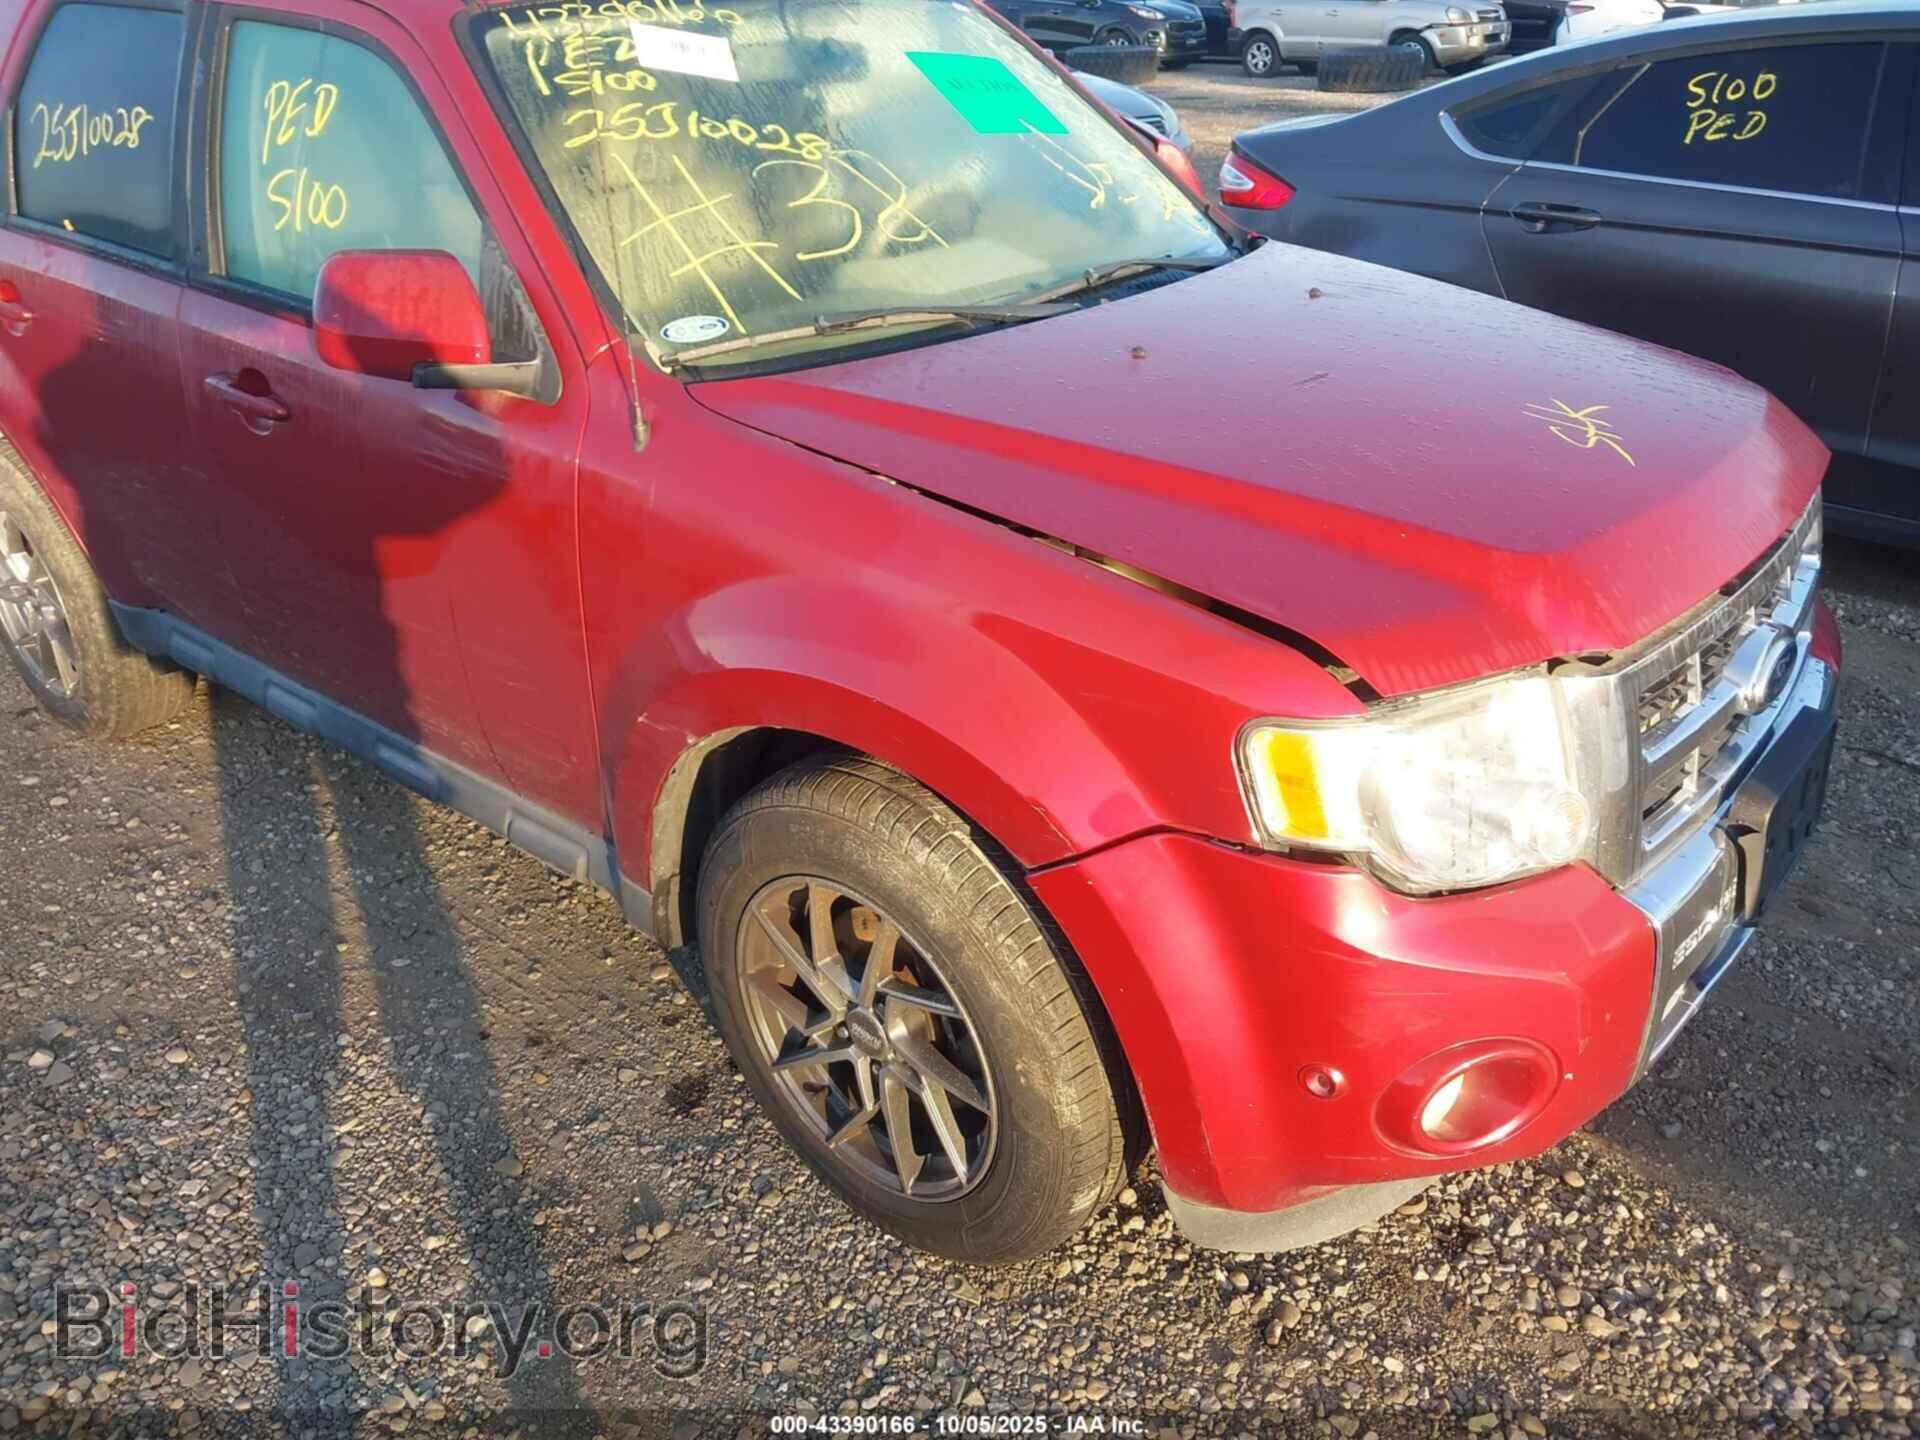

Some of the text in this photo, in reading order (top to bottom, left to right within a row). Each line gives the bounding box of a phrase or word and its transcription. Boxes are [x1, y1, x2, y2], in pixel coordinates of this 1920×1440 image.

[553, 69, 657, 96] S100
[30, 103, 154, 168] 25J10028
[263, 78, 339, 165] PED
[563, 101, 832, 161] 25J10028
[1683, 108, 1767, 144] PED
[266, 167, 347, 232] S100
